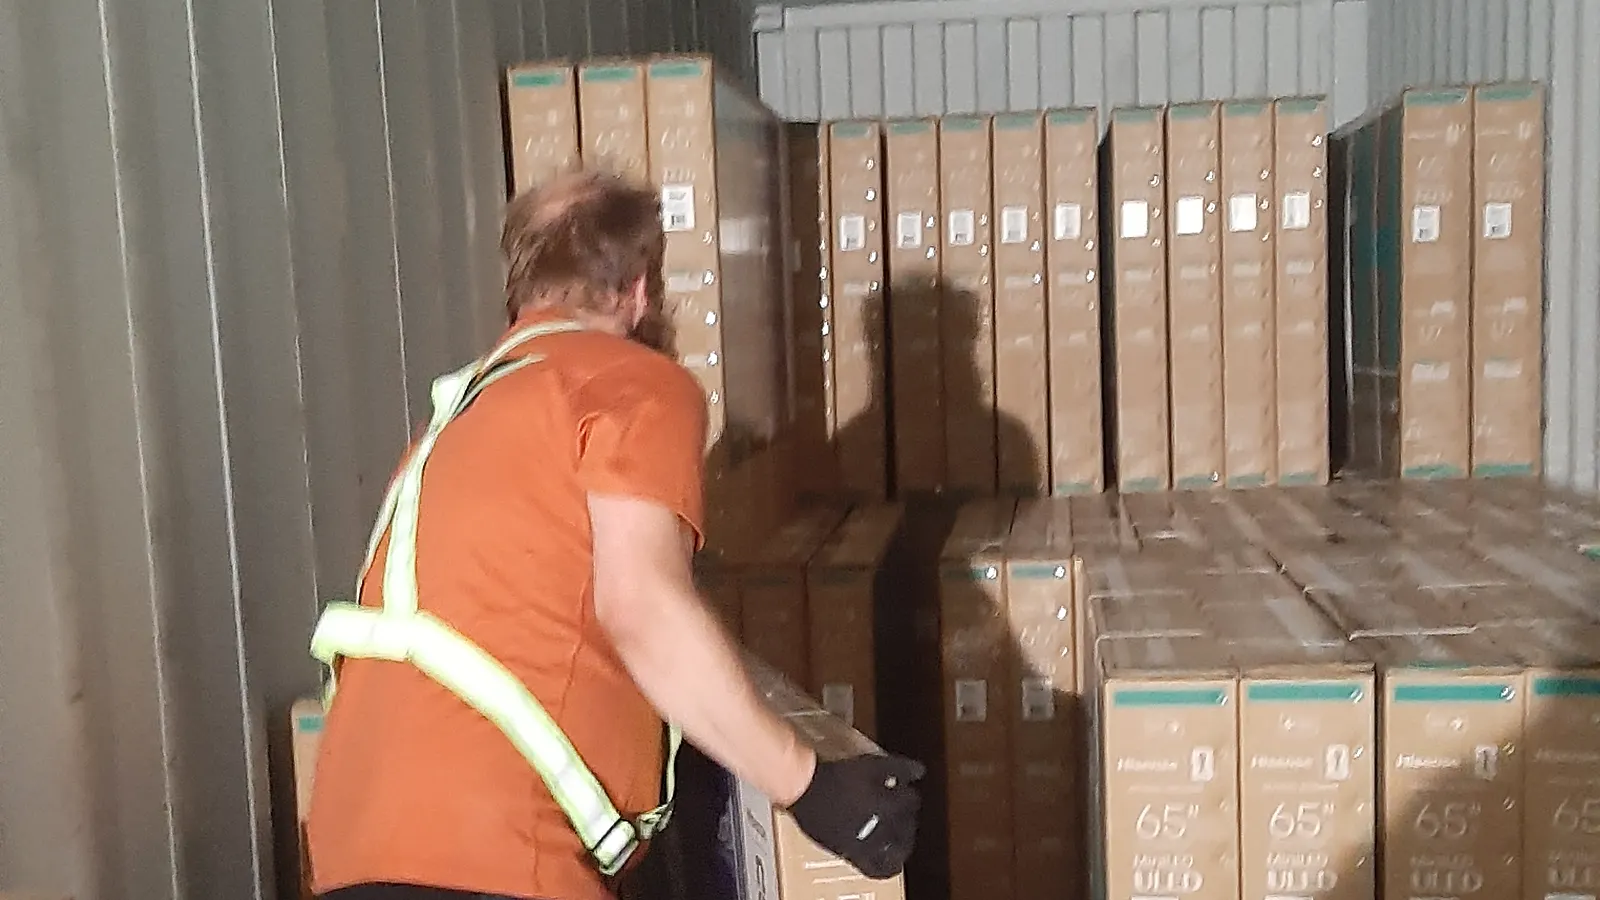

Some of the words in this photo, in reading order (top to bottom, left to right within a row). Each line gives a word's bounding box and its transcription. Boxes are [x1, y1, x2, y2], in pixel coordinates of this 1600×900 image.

[1136, 802, 1200, 839] 65"
[1268, 801, 1336, 838] 65"
[1414, 801, 1482, 838] 65"
